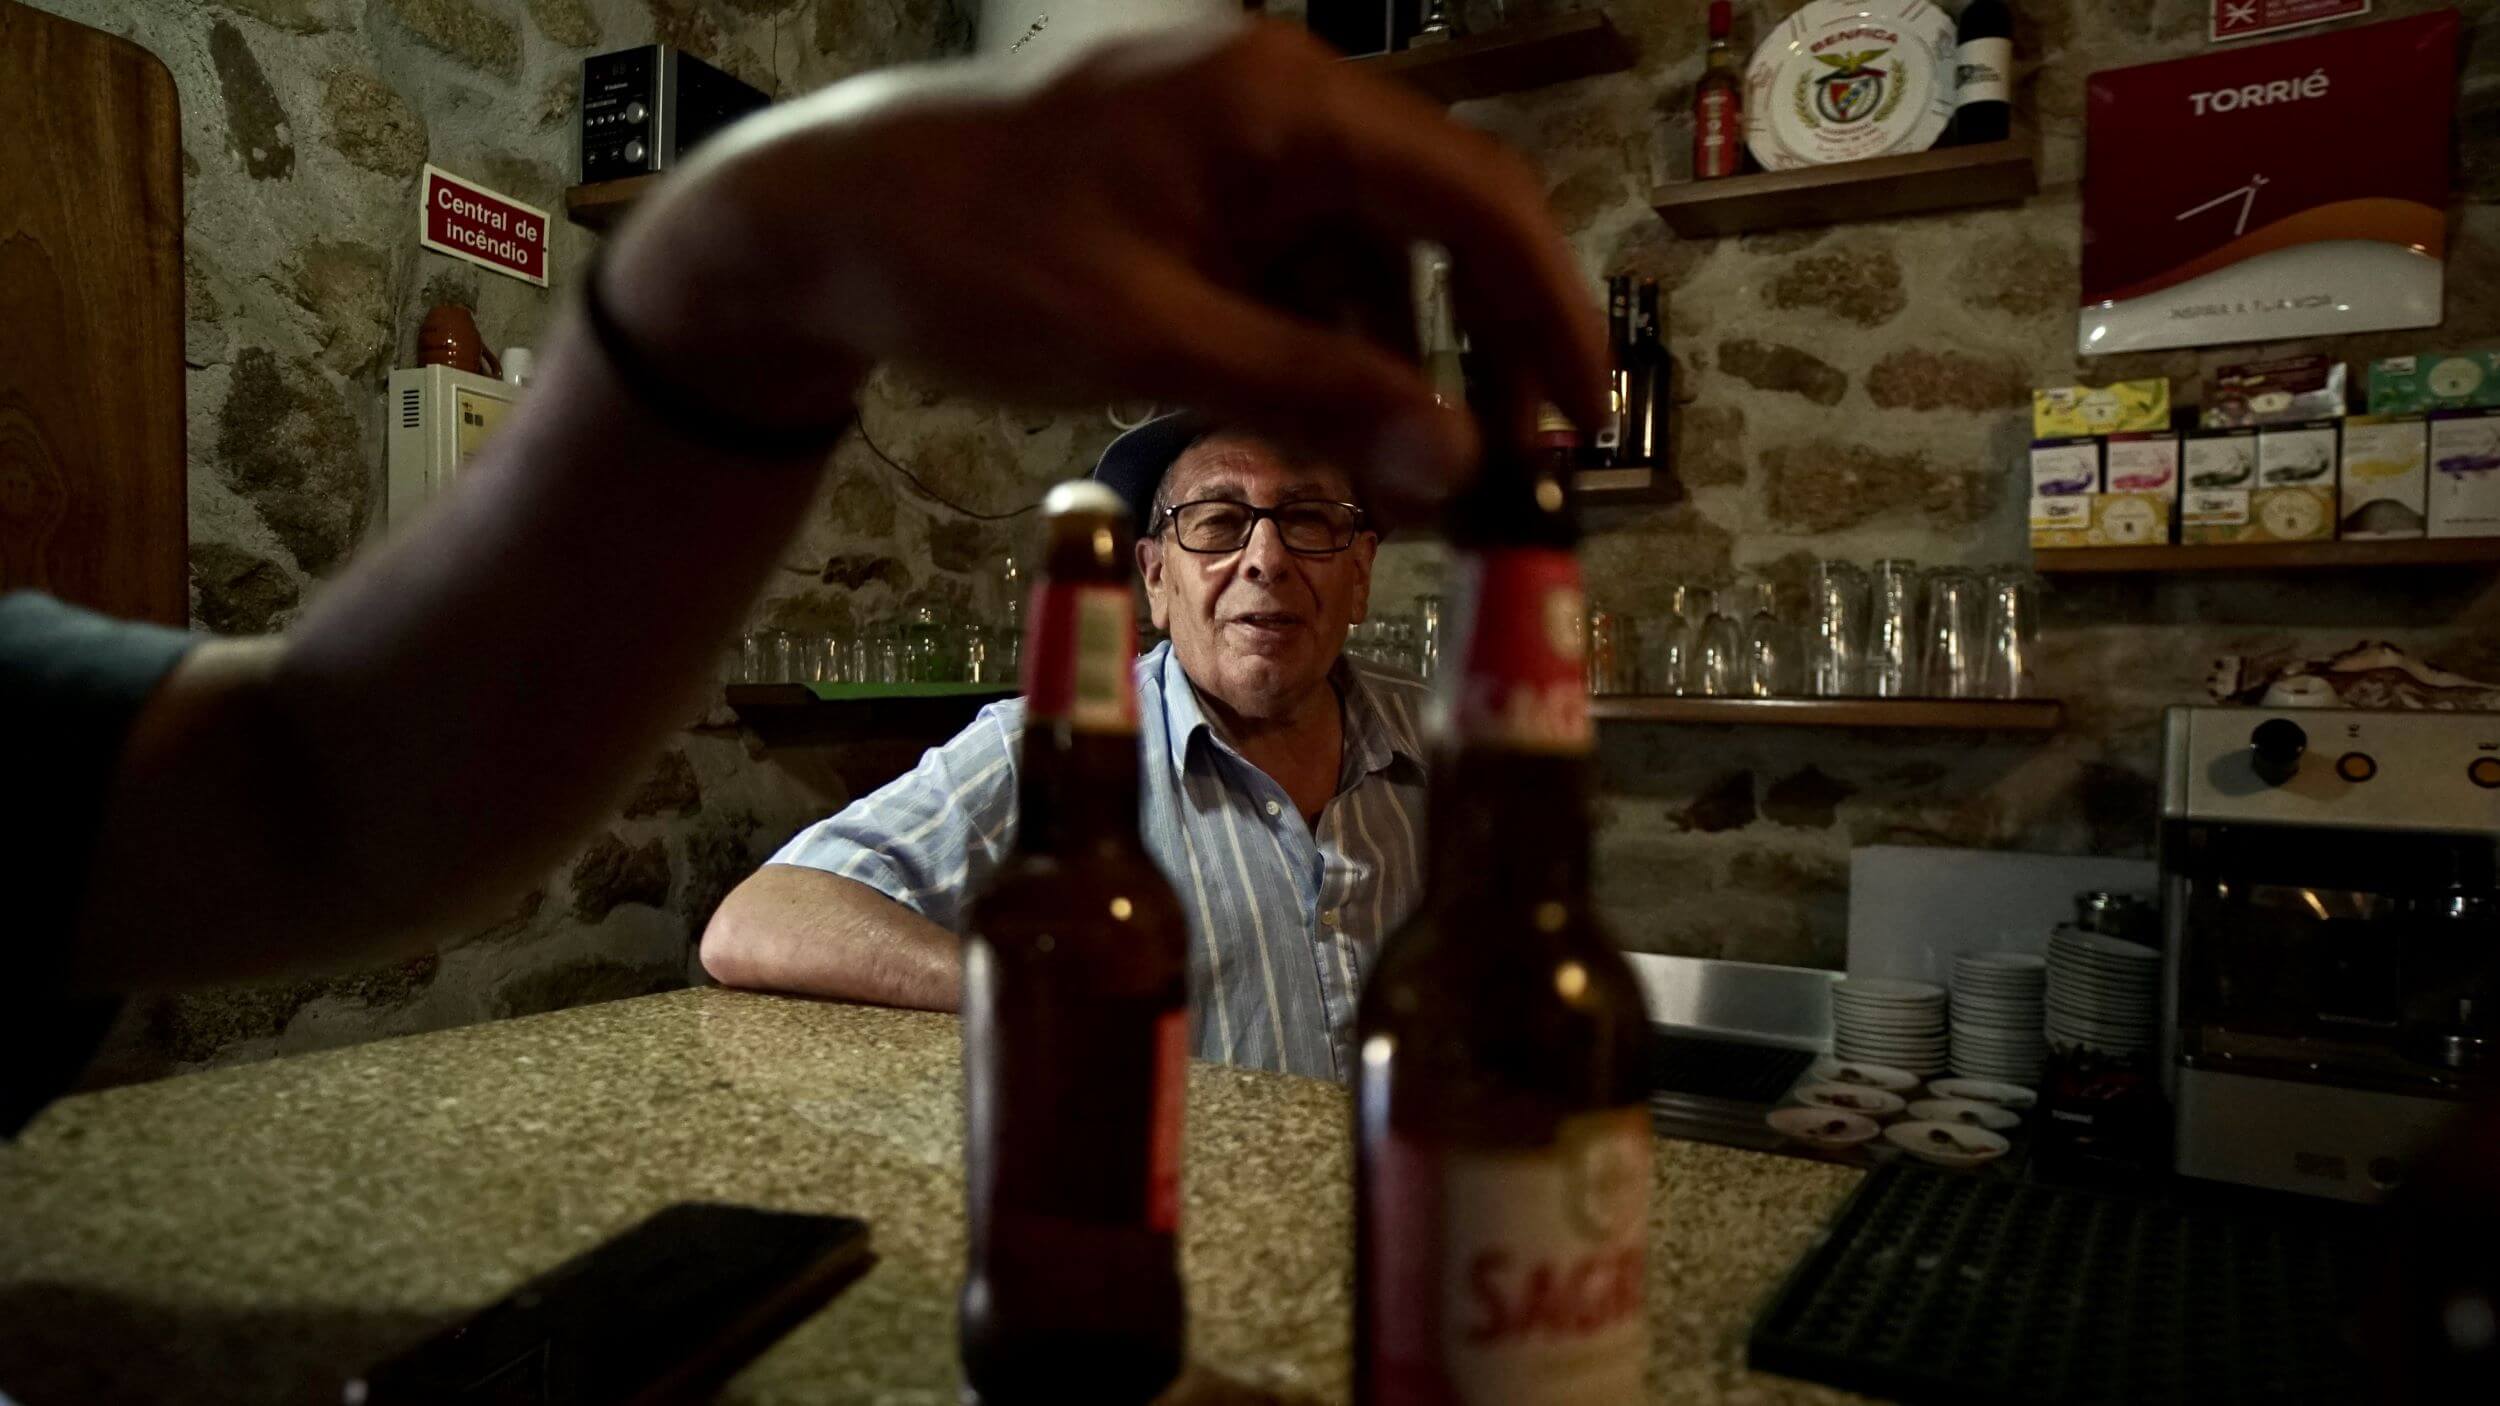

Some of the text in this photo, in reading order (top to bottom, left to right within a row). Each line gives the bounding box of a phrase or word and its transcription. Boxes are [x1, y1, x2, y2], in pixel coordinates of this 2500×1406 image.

[1810, 28, 1898, 53] BENFICA
[437, 187, 537, 242] Central de
[446, 217, 528, 265] incêndio
